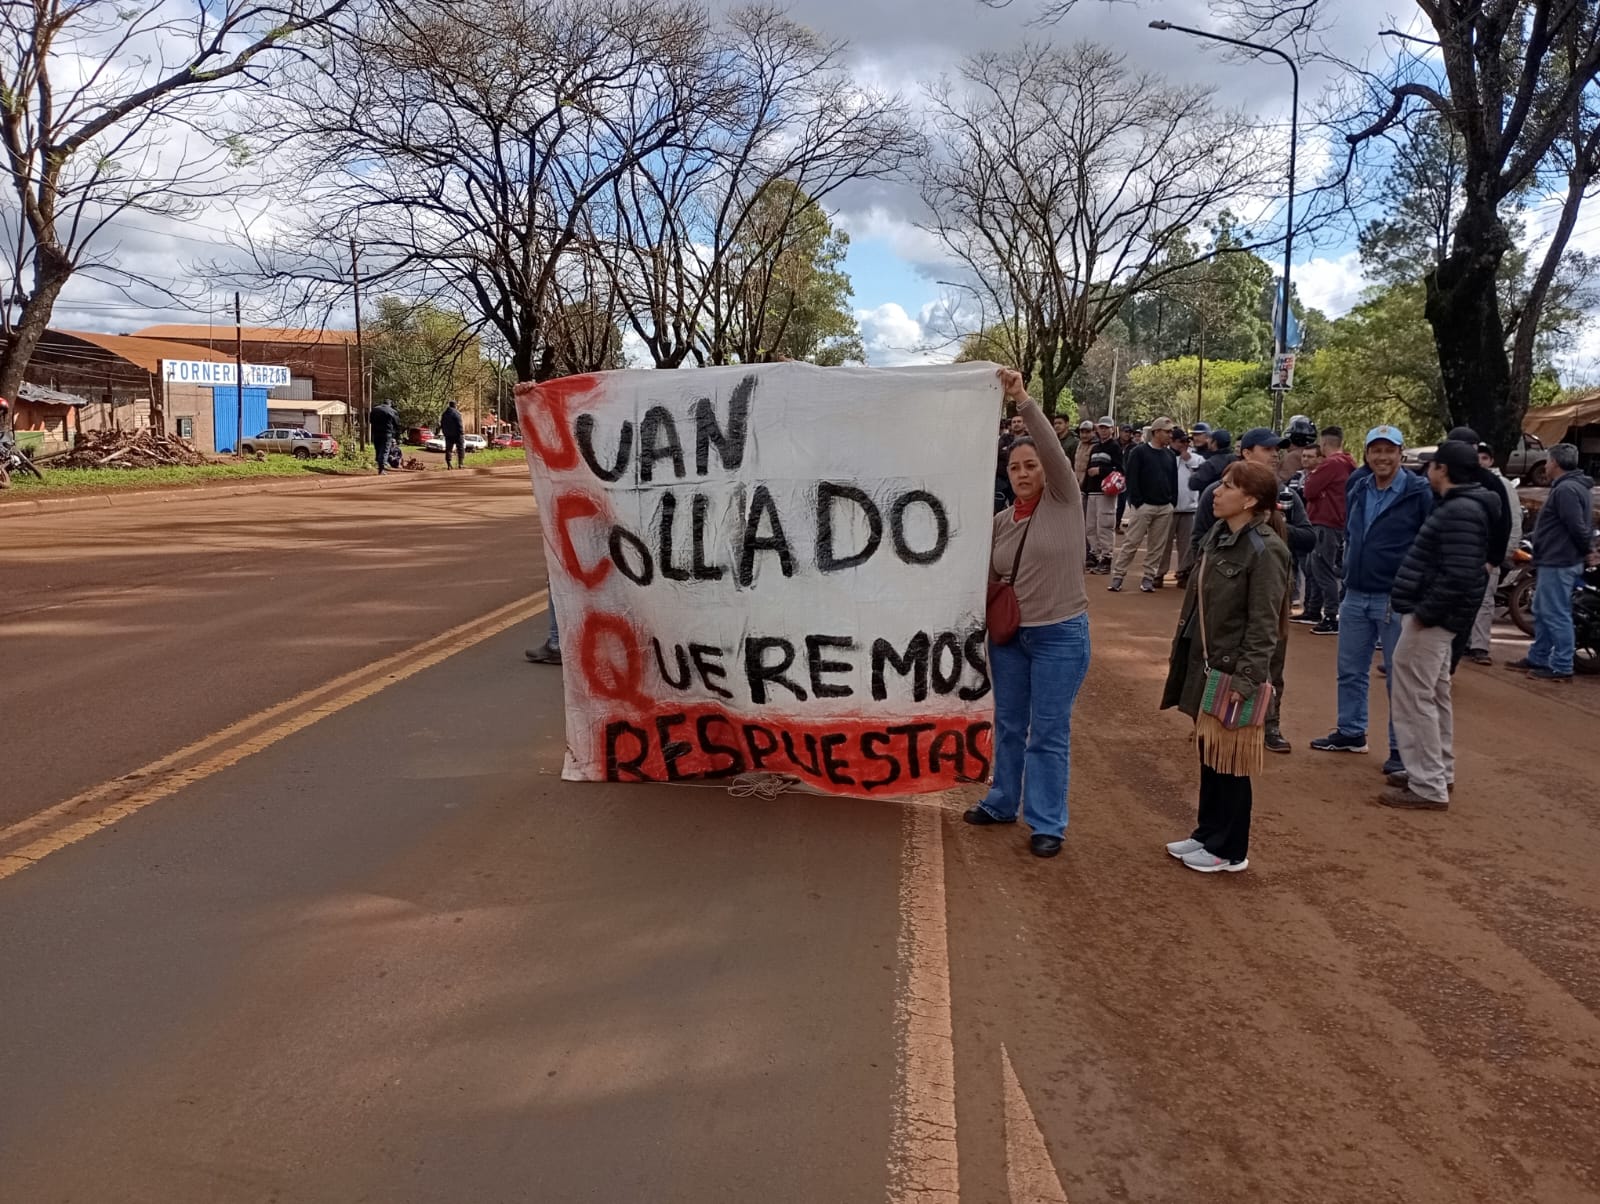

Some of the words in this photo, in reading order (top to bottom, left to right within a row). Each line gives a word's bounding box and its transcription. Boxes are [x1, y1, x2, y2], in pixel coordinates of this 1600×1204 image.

[250, 366, 287, 384] TARZAN
[521, 375, 758, 483] JUAN
[553, 481, 950, 590] COLLADO
[579, 612, 992, 711] QUEREMOS
[605, 713, 992, 790] RESPUESTAS
